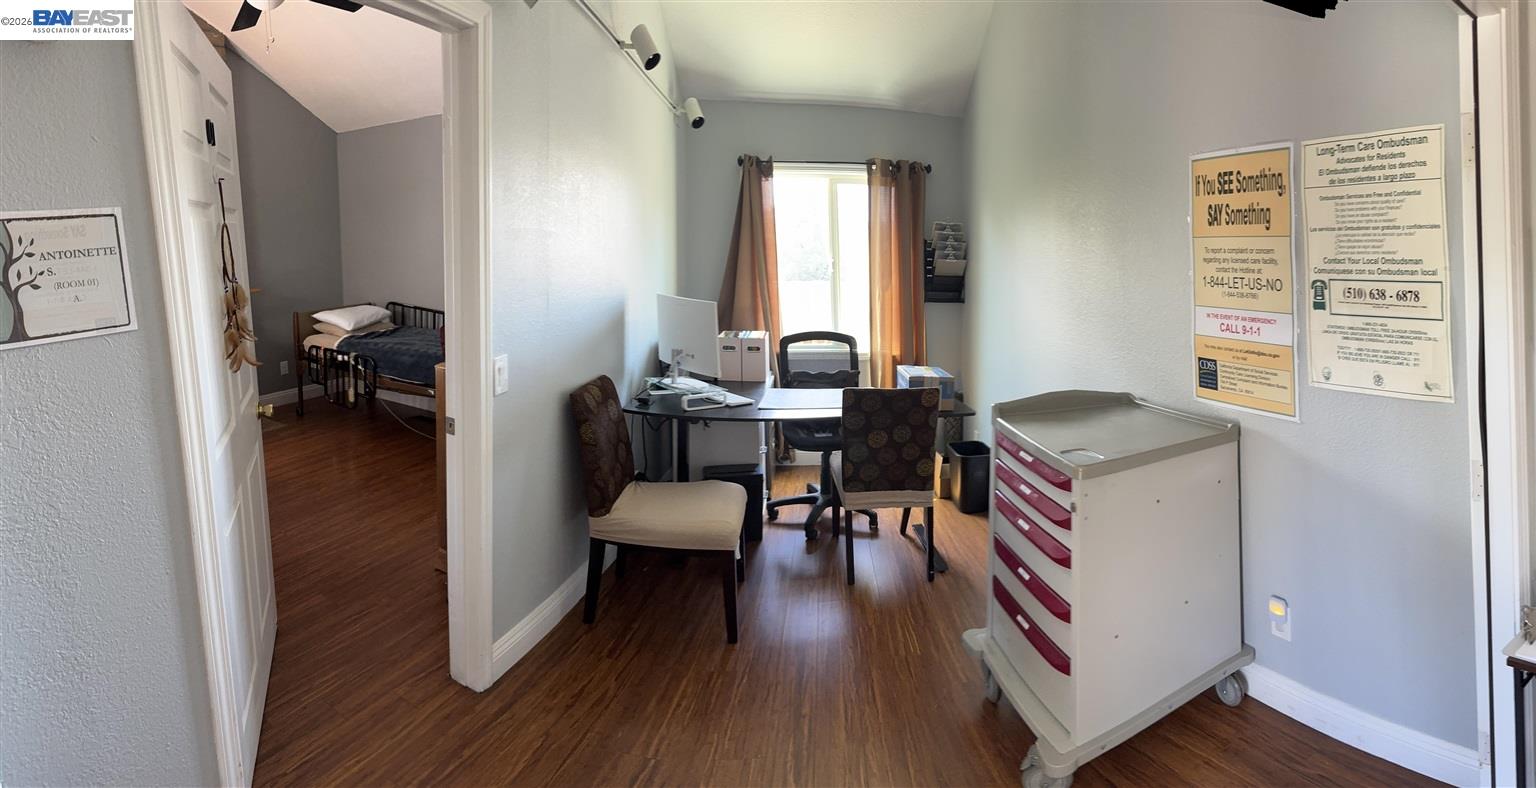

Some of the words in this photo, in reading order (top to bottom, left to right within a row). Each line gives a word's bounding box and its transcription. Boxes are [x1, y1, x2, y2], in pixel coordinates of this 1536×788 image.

[1316, 143, 1356, 156] Long-Term
[1357, 141, 1375, 152] Care
[1377, 135, 1428, 149] Ombudsman
[1336, 156, 1366, 164] Advocates
[1376, 151, 1406, 160] Residents
[1326, 167, 1360, 175] Ombudsman
[1362, 163, 1387, 172] defiende
[1398, 160, 1427, 169] derechos
[1195, 175, 1201, 196] If
[1201, 174, 1216, 196] You
[1217, 170, 1234, 195] SEE
[1235, 167, 1287, 197] Something,
[1347, 175, 1377, 183] residentes
[1383, 173, 1398, 182] largo
[1399, 172, 1417, 180] plazo
[1207, 203, 1224, 226] SAY
[1225, 201, 1271, 231] Something
[39, 246, 118, 261] ANTOINETTE
[1204, 246, 1210, 254] To
[1210, 247, 1223, 255] report
[1323, 257, 1346, 265] Contact
[1347, 257, 1361, 265] Your
[1362, 256, 1379, 265] Local
[1380, 256, 1423, 265] Ombudsman
[46, 266, 57, 277] S.
[1376, 267, 1419, 276] Ombudsman
[1421, 268, 1438, 276] local
[53, 279, 85, 291] (ROOM
[1202, 275, 1283, 292] 1-844-LET-US-NO
[1342, 287, 1367, 301] (510)
[1369, 288, 1387, 301] 638
[1395, 289, 1421, 302] 6878
[1247, 316, 1277, 325] EMERGENCY
[1219, 322, 1240, 334] CALL
[1241, 325, 1261, 336] 9-1-1
[1199, 359, 1216, 371] CDSS
